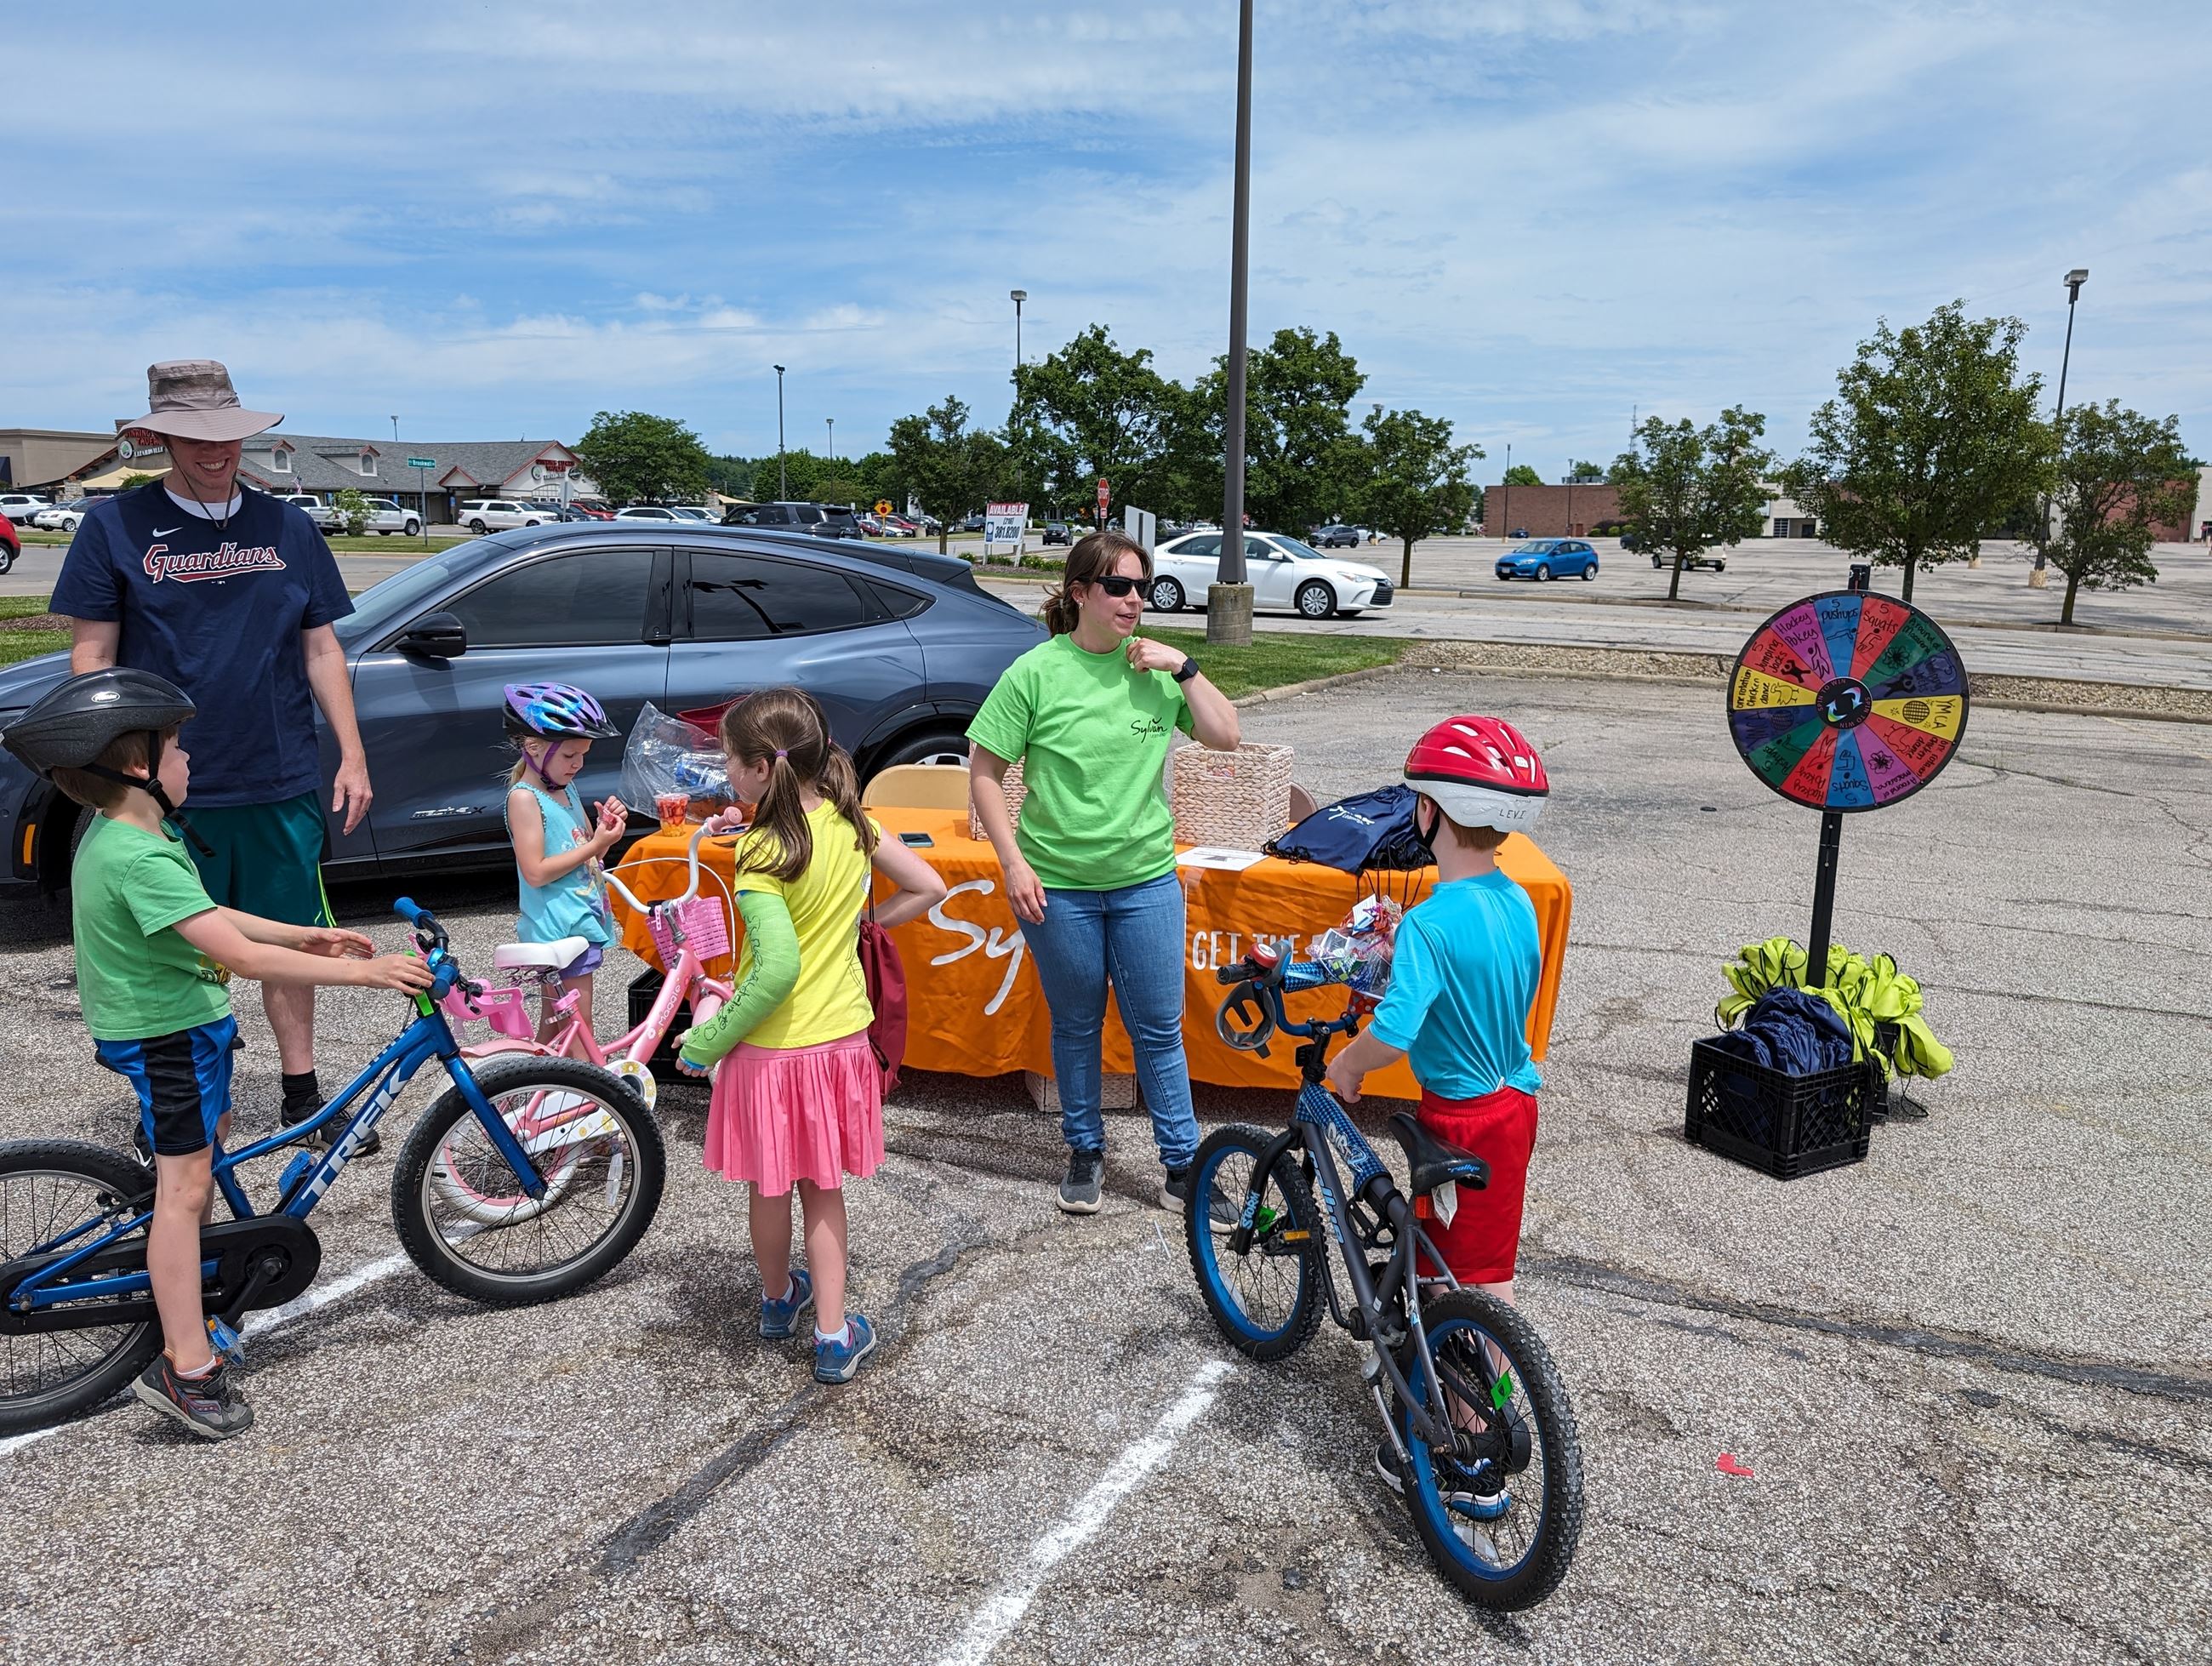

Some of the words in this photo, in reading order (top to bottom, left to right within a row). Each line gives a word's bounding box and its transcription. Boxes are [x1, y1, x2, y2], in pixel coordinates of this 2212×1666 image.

[989, 505, 1023, 515] AVAILABLE
[143, 542, 287, 584] Guardians
[1831, 598, 1840, 608] 5
[1879, 603, 1890, 614] 5
[1776, 613, 1812, 635] Hockey
[1821, 685, 1830, 693] TO
[1856, 715, 1866, 723] TO
[1932, 698, 1956, 729] YMCA
[1131, 717, 1168, 743] Sylvan
[1499, 808, 1527, 819] LEVI
[1193, 930, 1242, 971] GET
[300, 1067, 411, 1201] TREK
[1240, 1190, 1261, 1230] STORM
